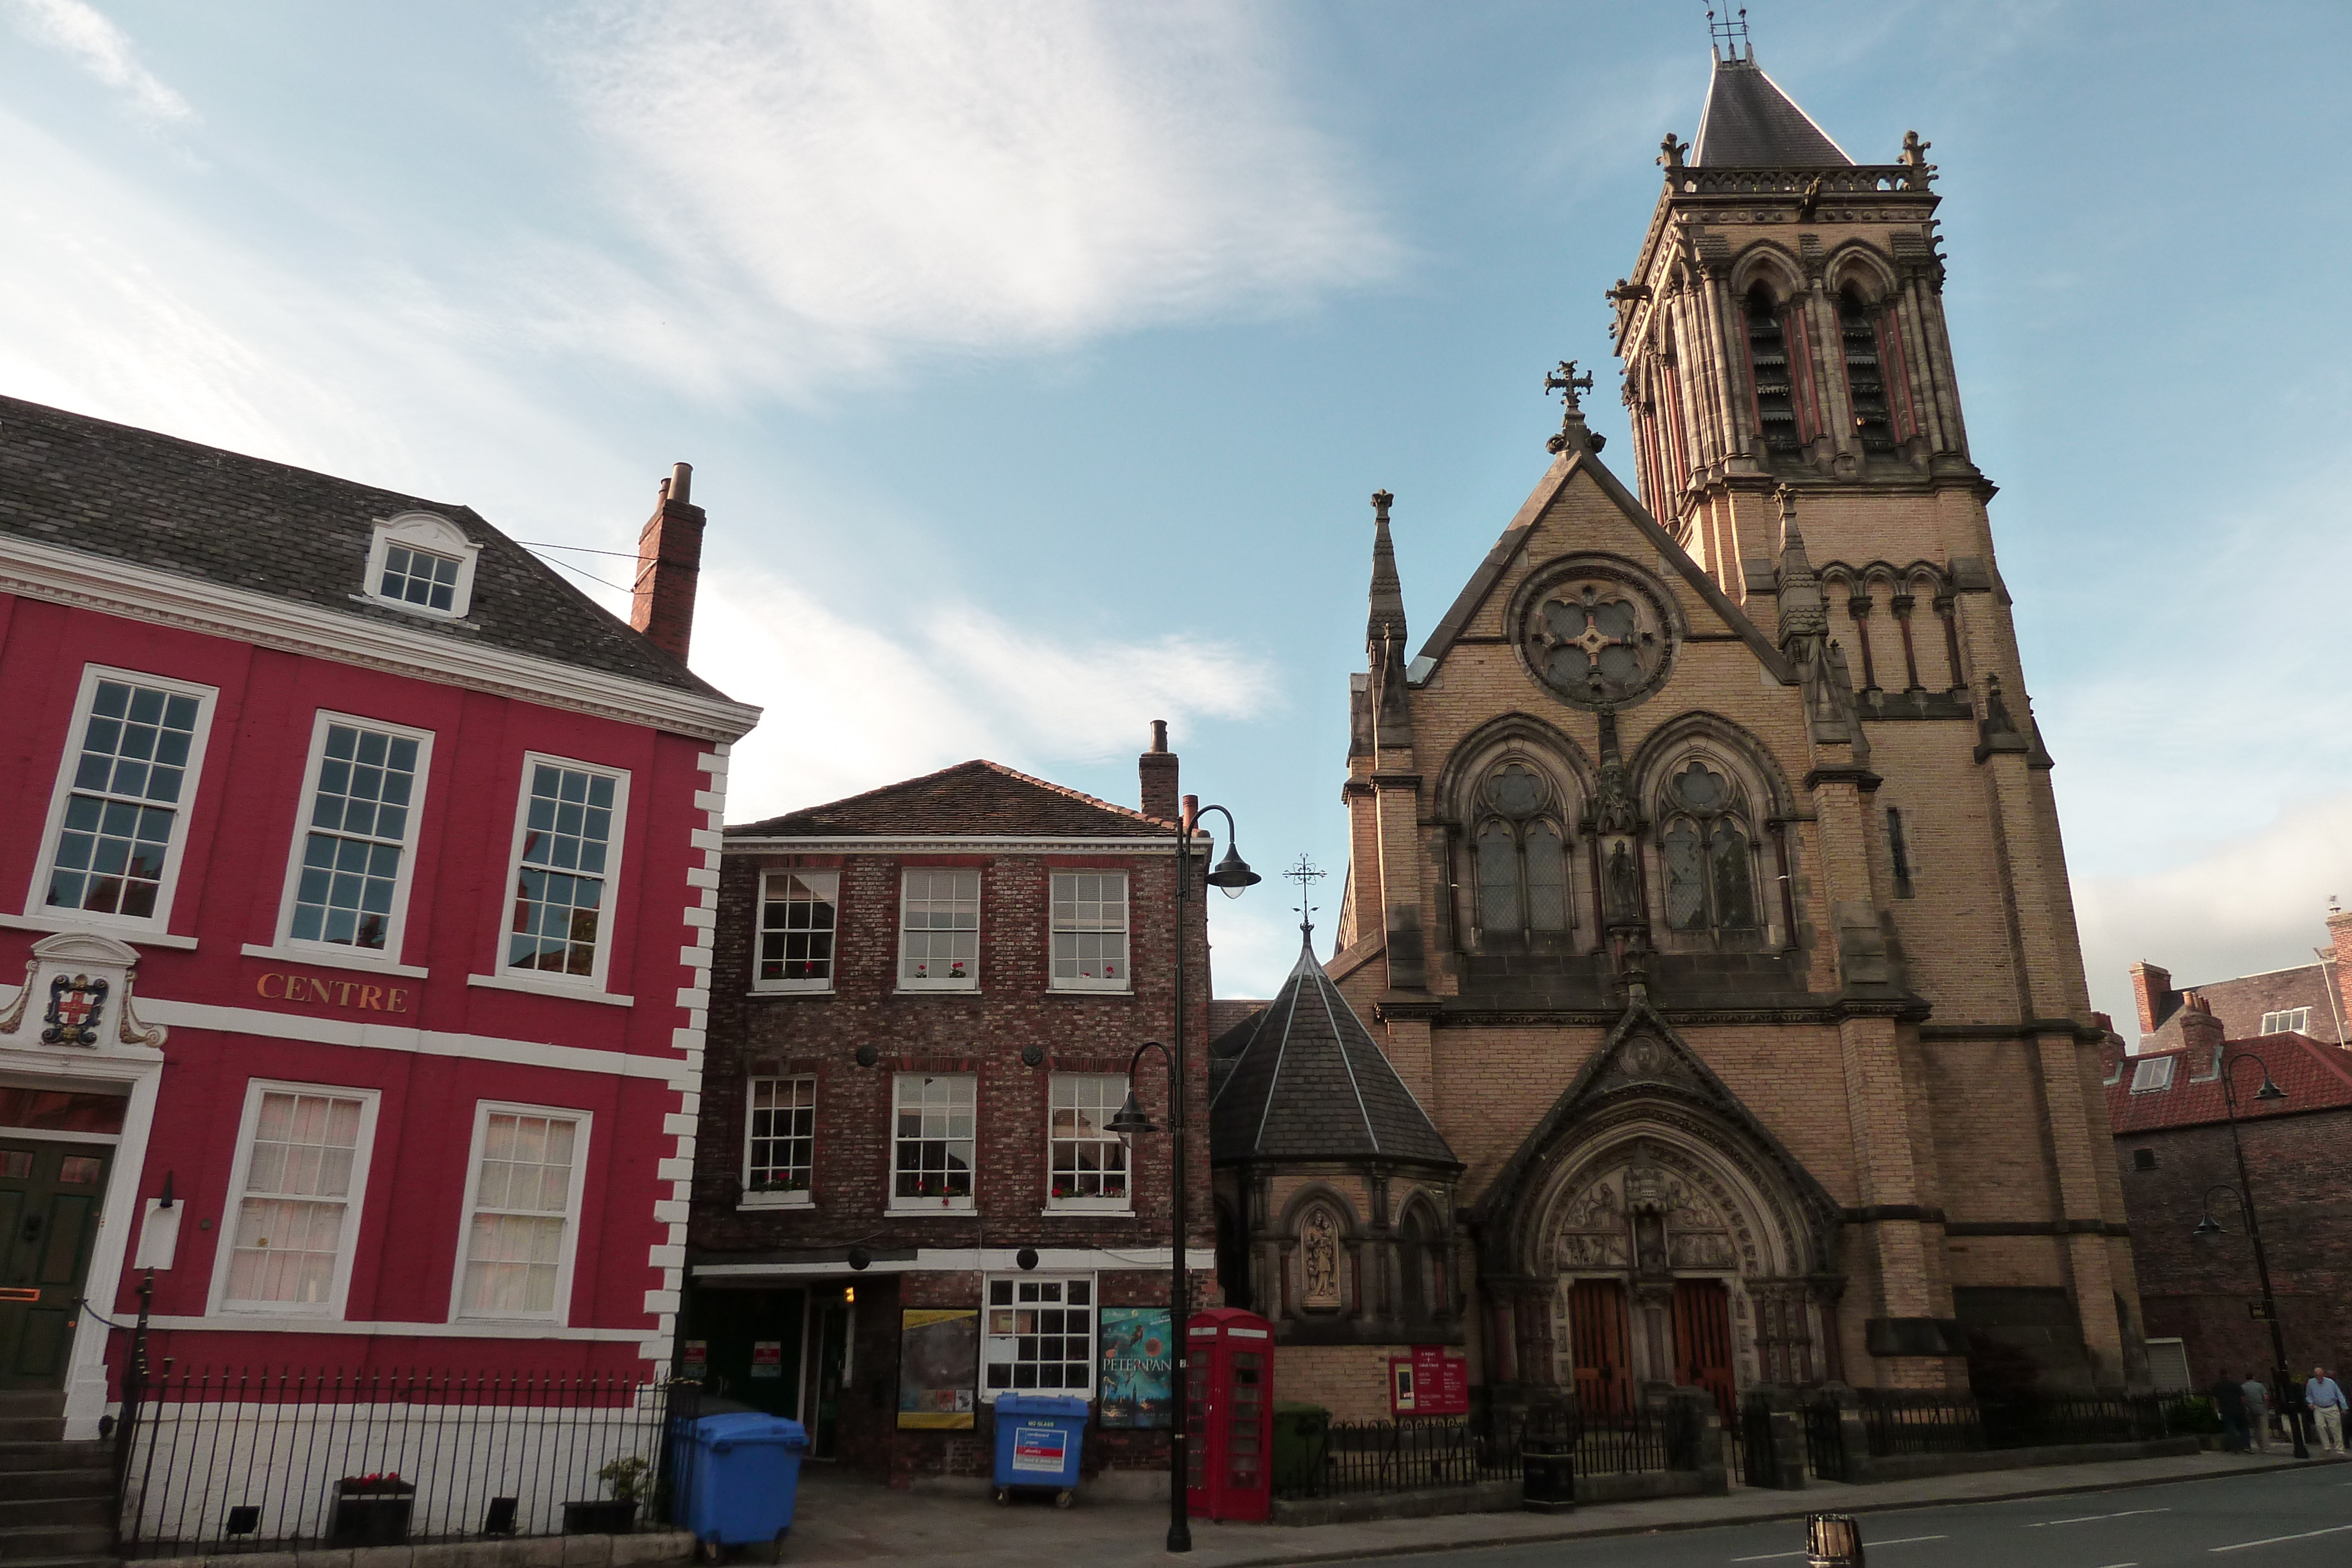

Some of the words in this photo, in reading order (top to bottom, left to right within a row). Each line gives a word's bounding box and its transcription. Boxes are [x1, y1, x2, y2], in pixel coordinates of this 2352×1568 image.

[256, 973, 408, 1012] CENTRE
[1103, 1359, 1141, 1370] PETER
[1147, 1359, 1172, 1371] PAN
